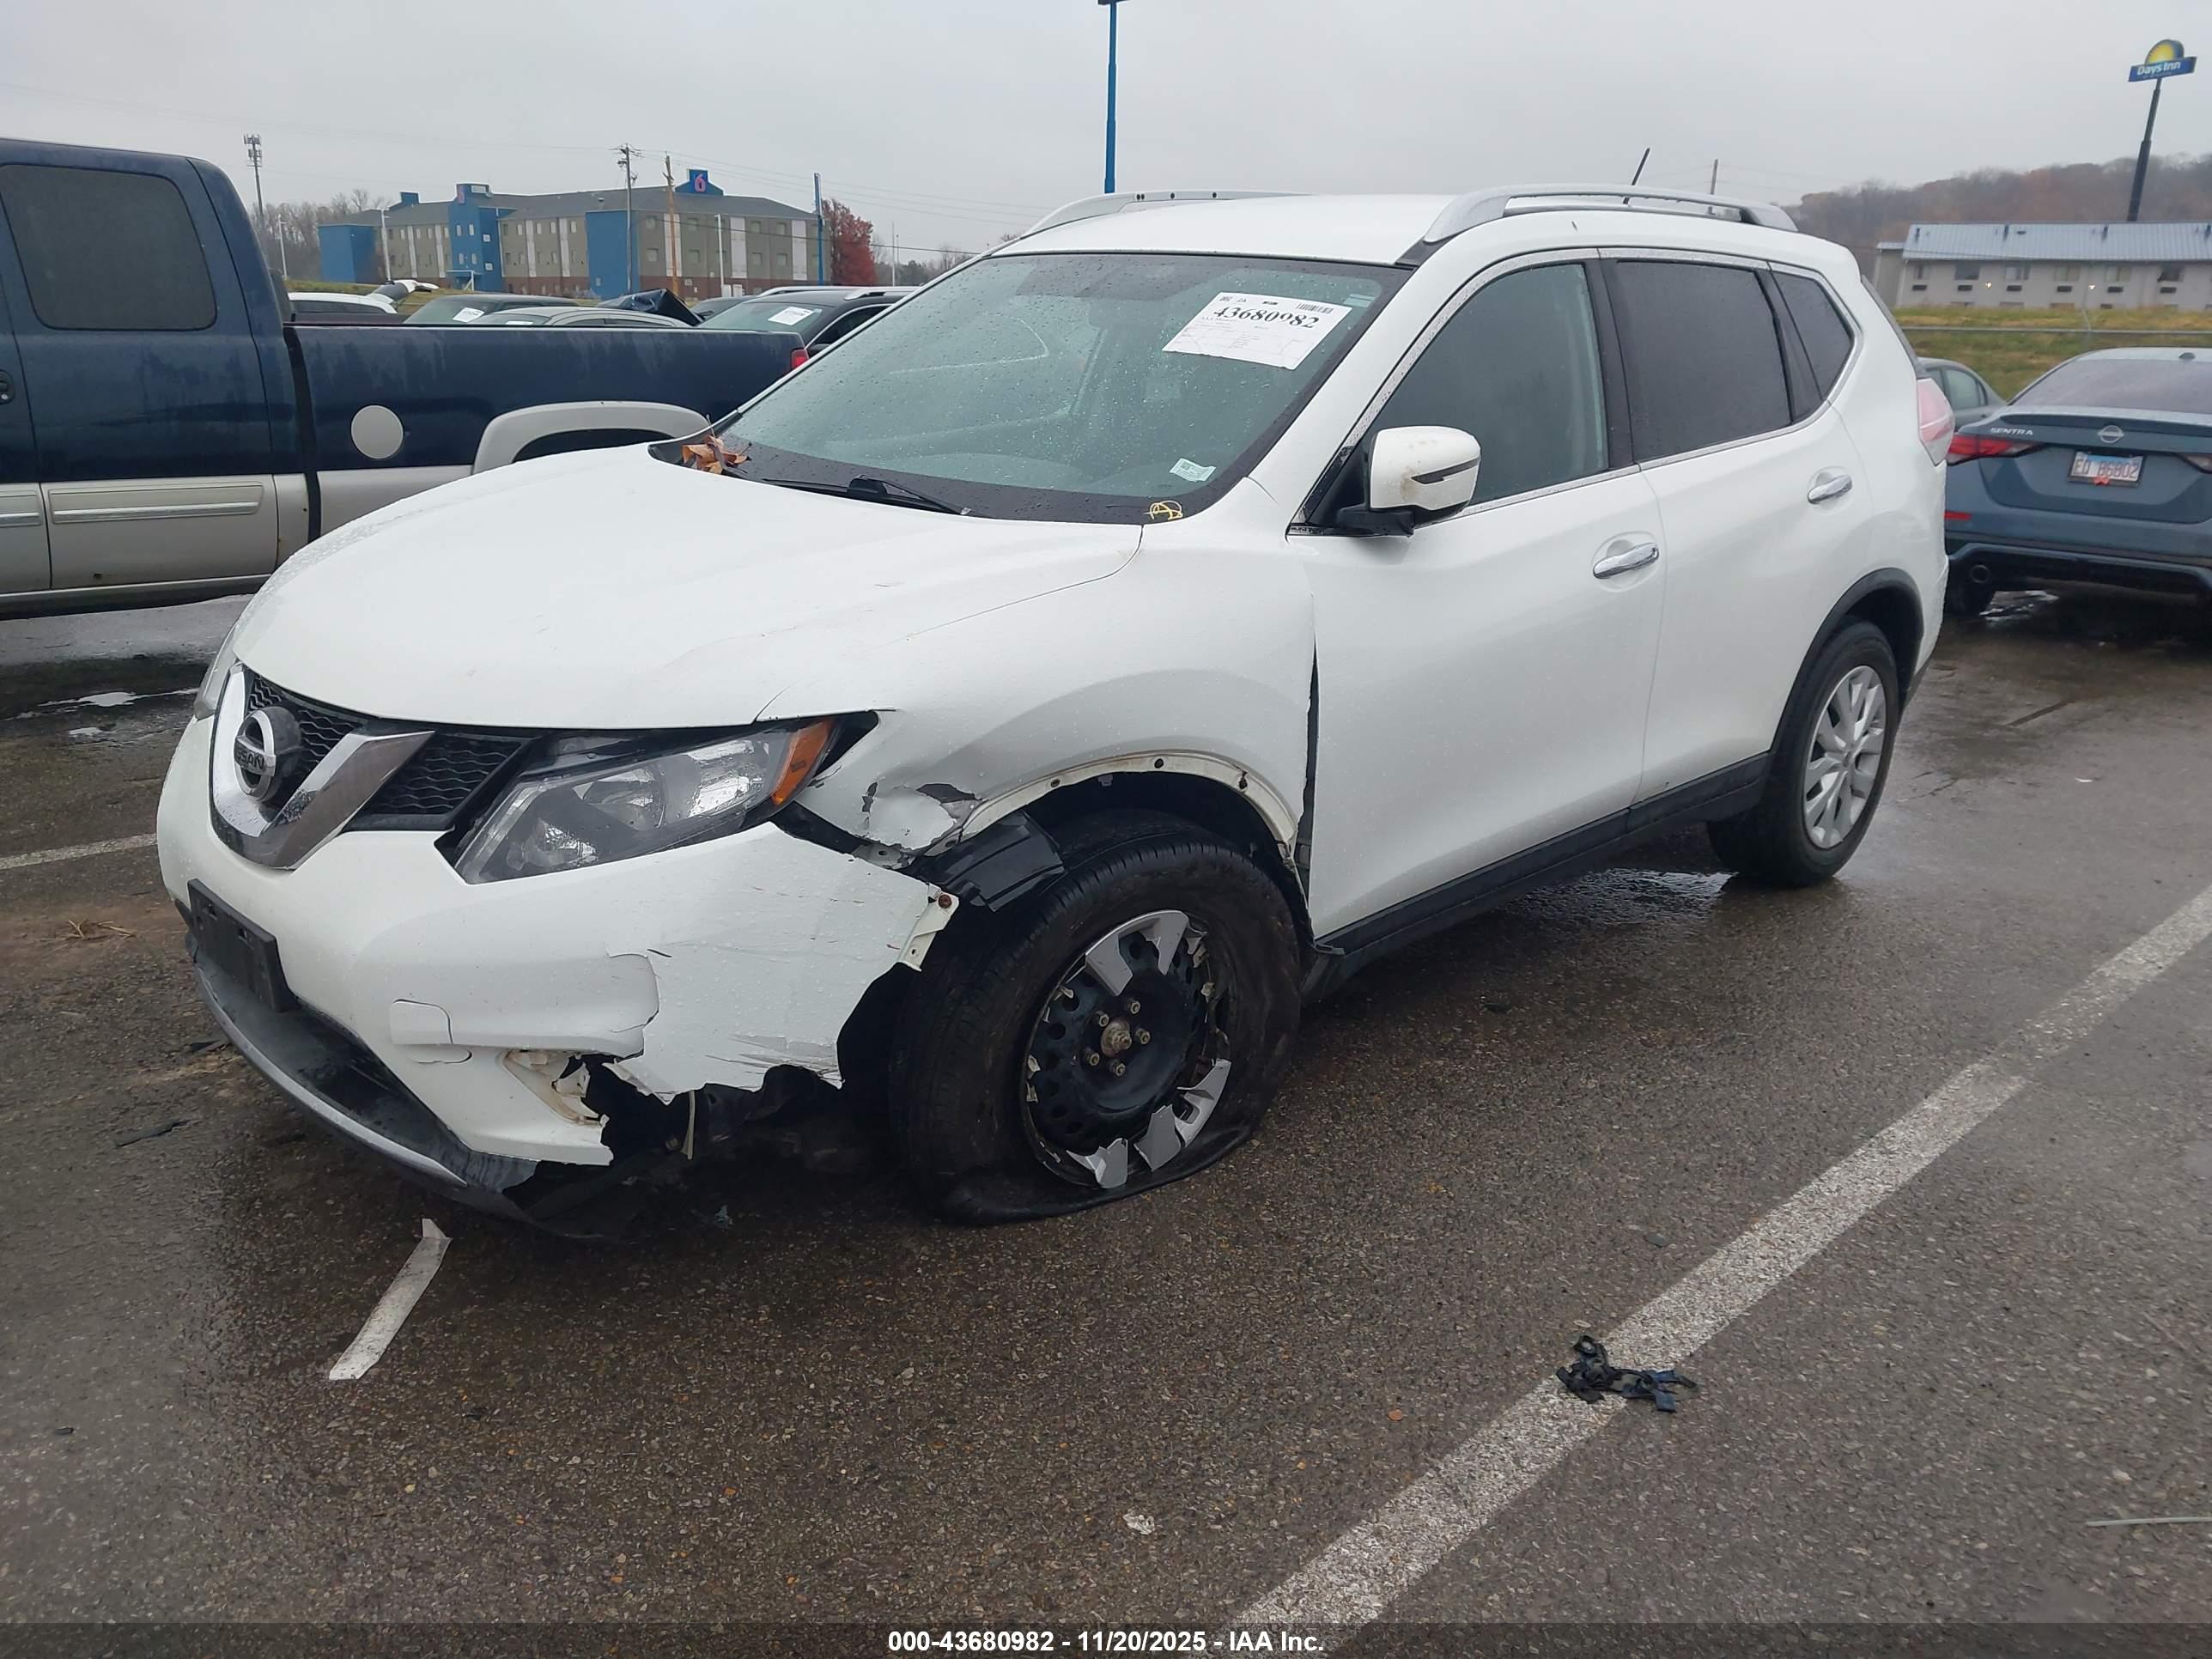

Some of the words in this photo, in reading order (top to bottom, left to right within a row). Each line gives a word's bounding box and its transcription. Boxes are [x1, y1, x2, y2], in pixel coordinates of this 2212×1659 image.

[2136, 64, 2162, 76] Days
[2163, 62, 2181, 70] Inn
[694, 173, 707, 193] 6
[1213, 307, 1320, 329] 43680982
